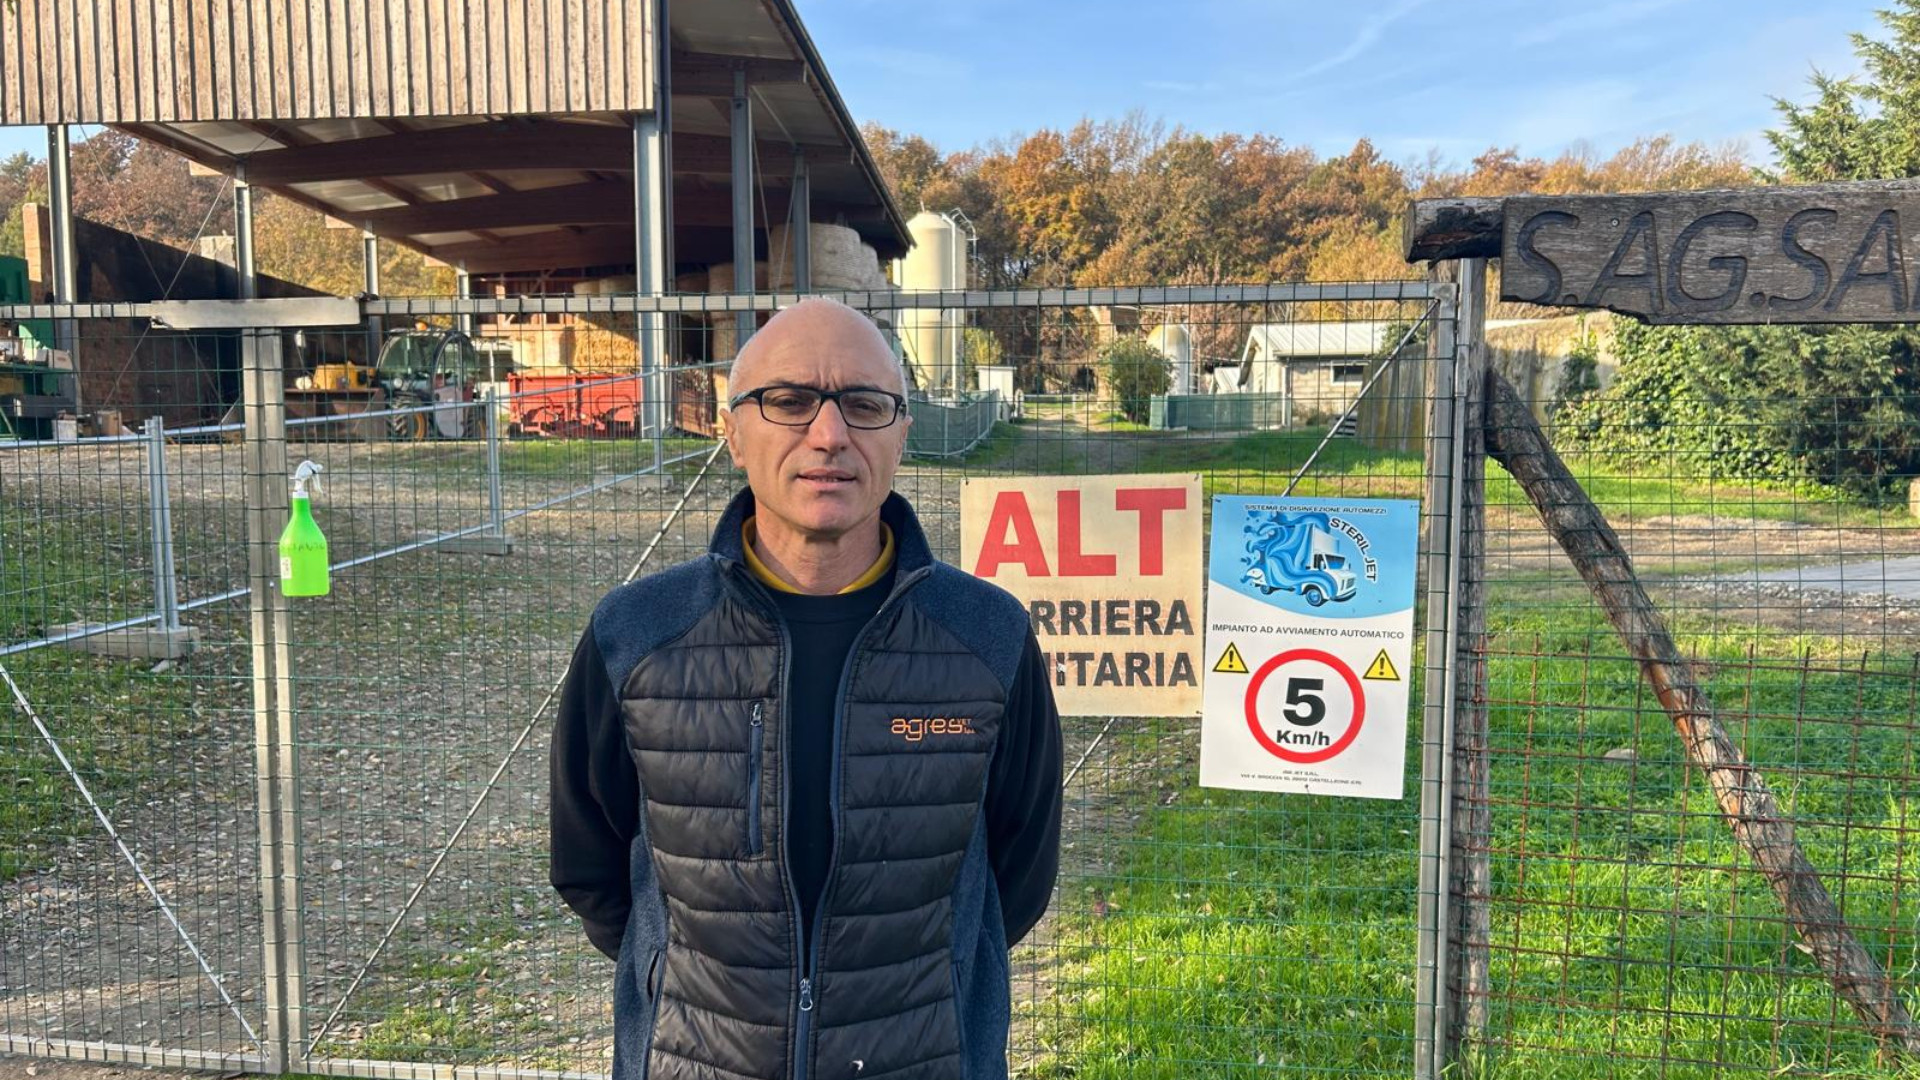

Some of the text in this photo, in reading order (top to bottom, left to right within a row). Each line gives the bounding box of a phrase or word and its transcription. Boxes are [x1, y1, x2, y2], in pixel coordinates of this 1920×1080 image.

[1503, 207, 1920, 314] S.AG.SA
[974, 487, 1187, 577] ALT
[1330, 518, 1377, 581] STERIL JET
[1030, 600, 1194, 636] RRIERA
[1212, 624, 1257, 633] IMPIANTO
[1275, 628, 1338, 637] AVVIAMENTO
[1340, 630, 1404, 639] AUTOMATICO
[1043, 652, 1197, 687] ITARIA
[1283, 677, 1326, 727] 5
[891, 718, 963, 741] agres
[1276, 730, 1330, 746] Km/h
